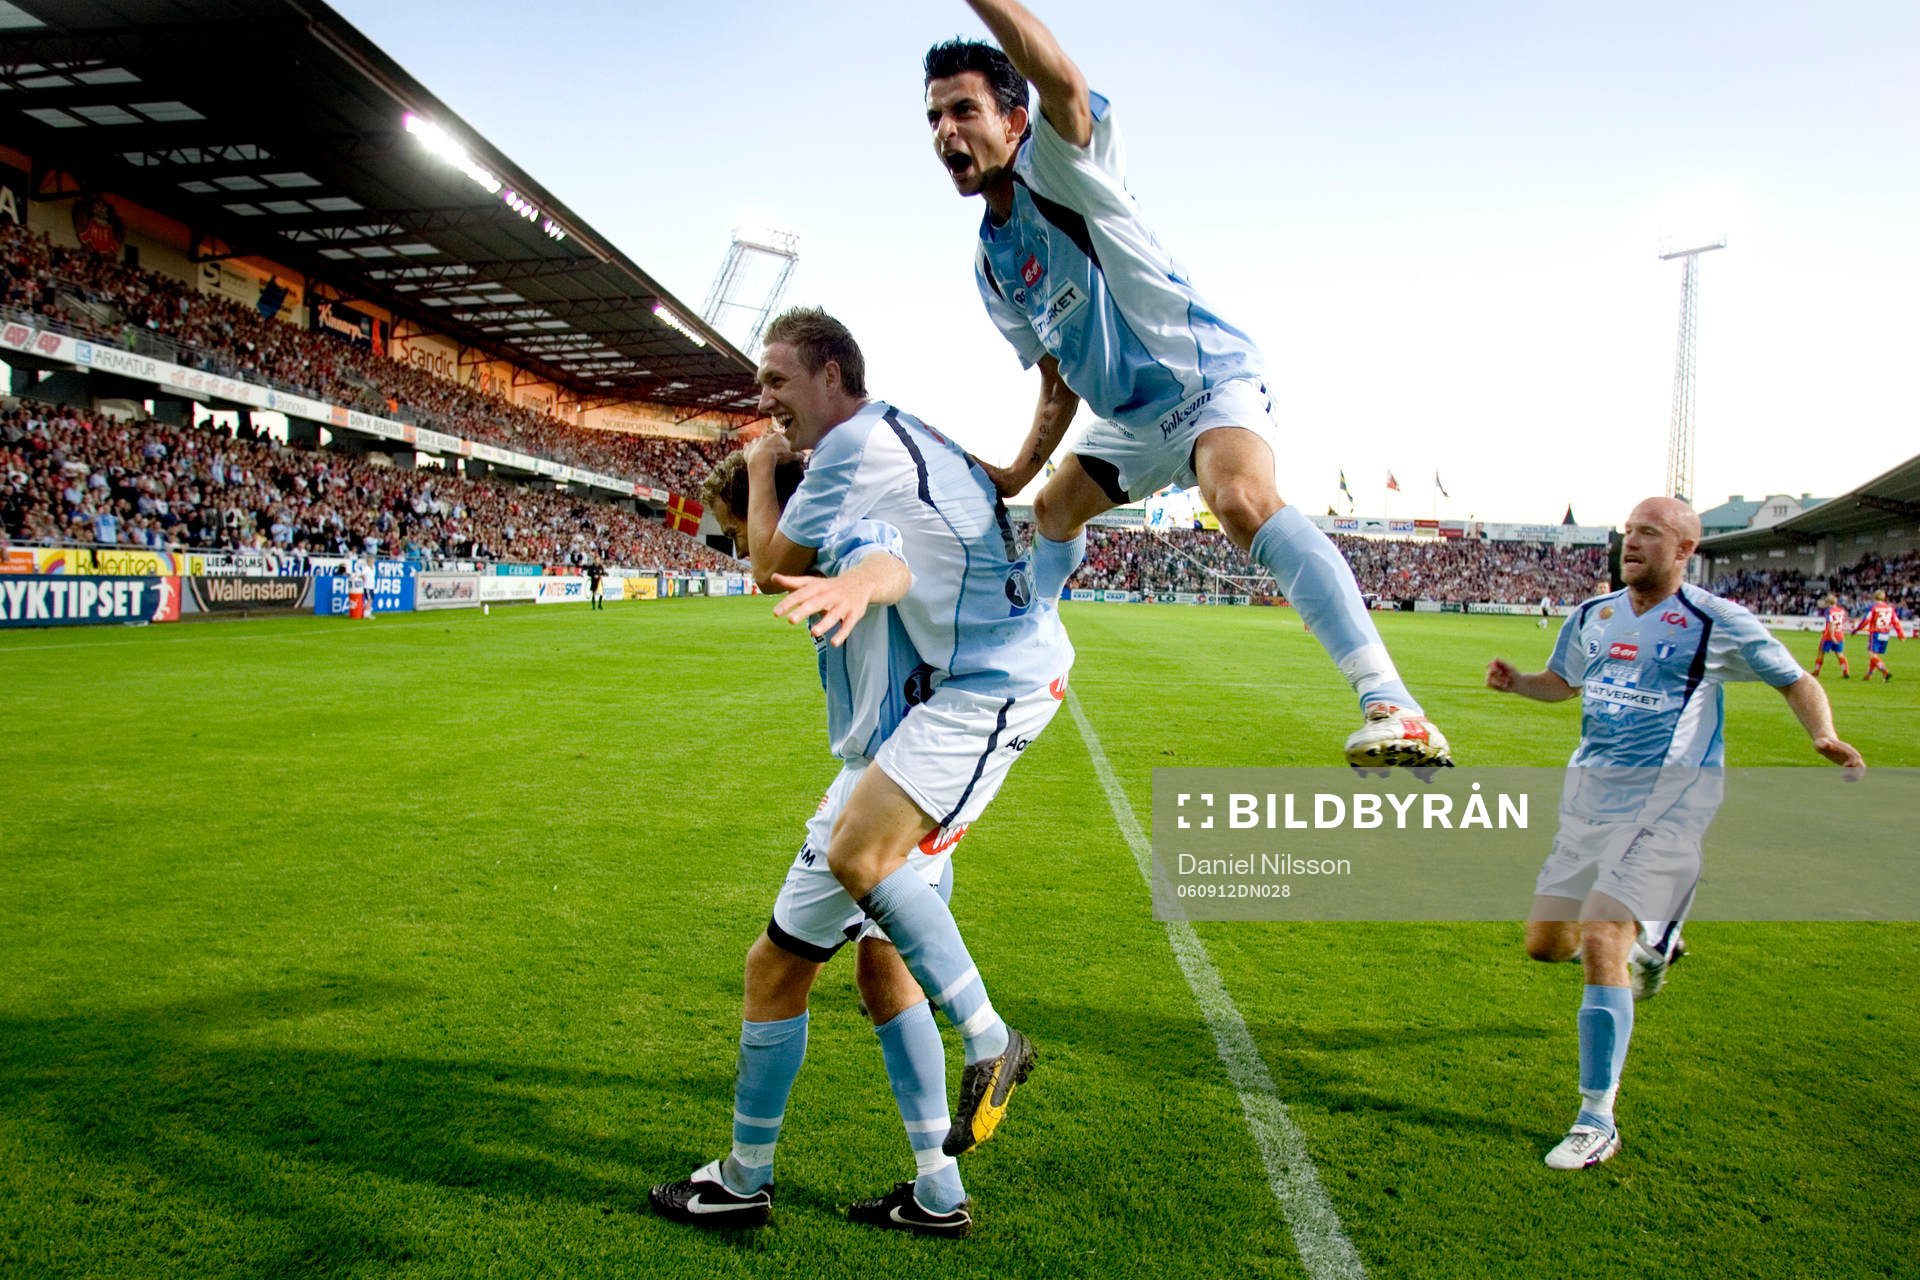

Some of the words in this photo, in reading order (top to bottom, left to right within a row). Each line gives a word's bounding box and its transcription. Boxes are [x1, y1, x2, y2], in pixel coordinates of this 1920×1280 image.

[94, 349, 157, 378] ARMATUR
[400, 338, 454, 379] Scandic
[1160, 392, 1212, 440] Folksam
[207, 556, 264, 568] LIEDOLMS
[207, 579, 298, 601] Wallenstam
[1660, 611, 1688, 629] ICA
